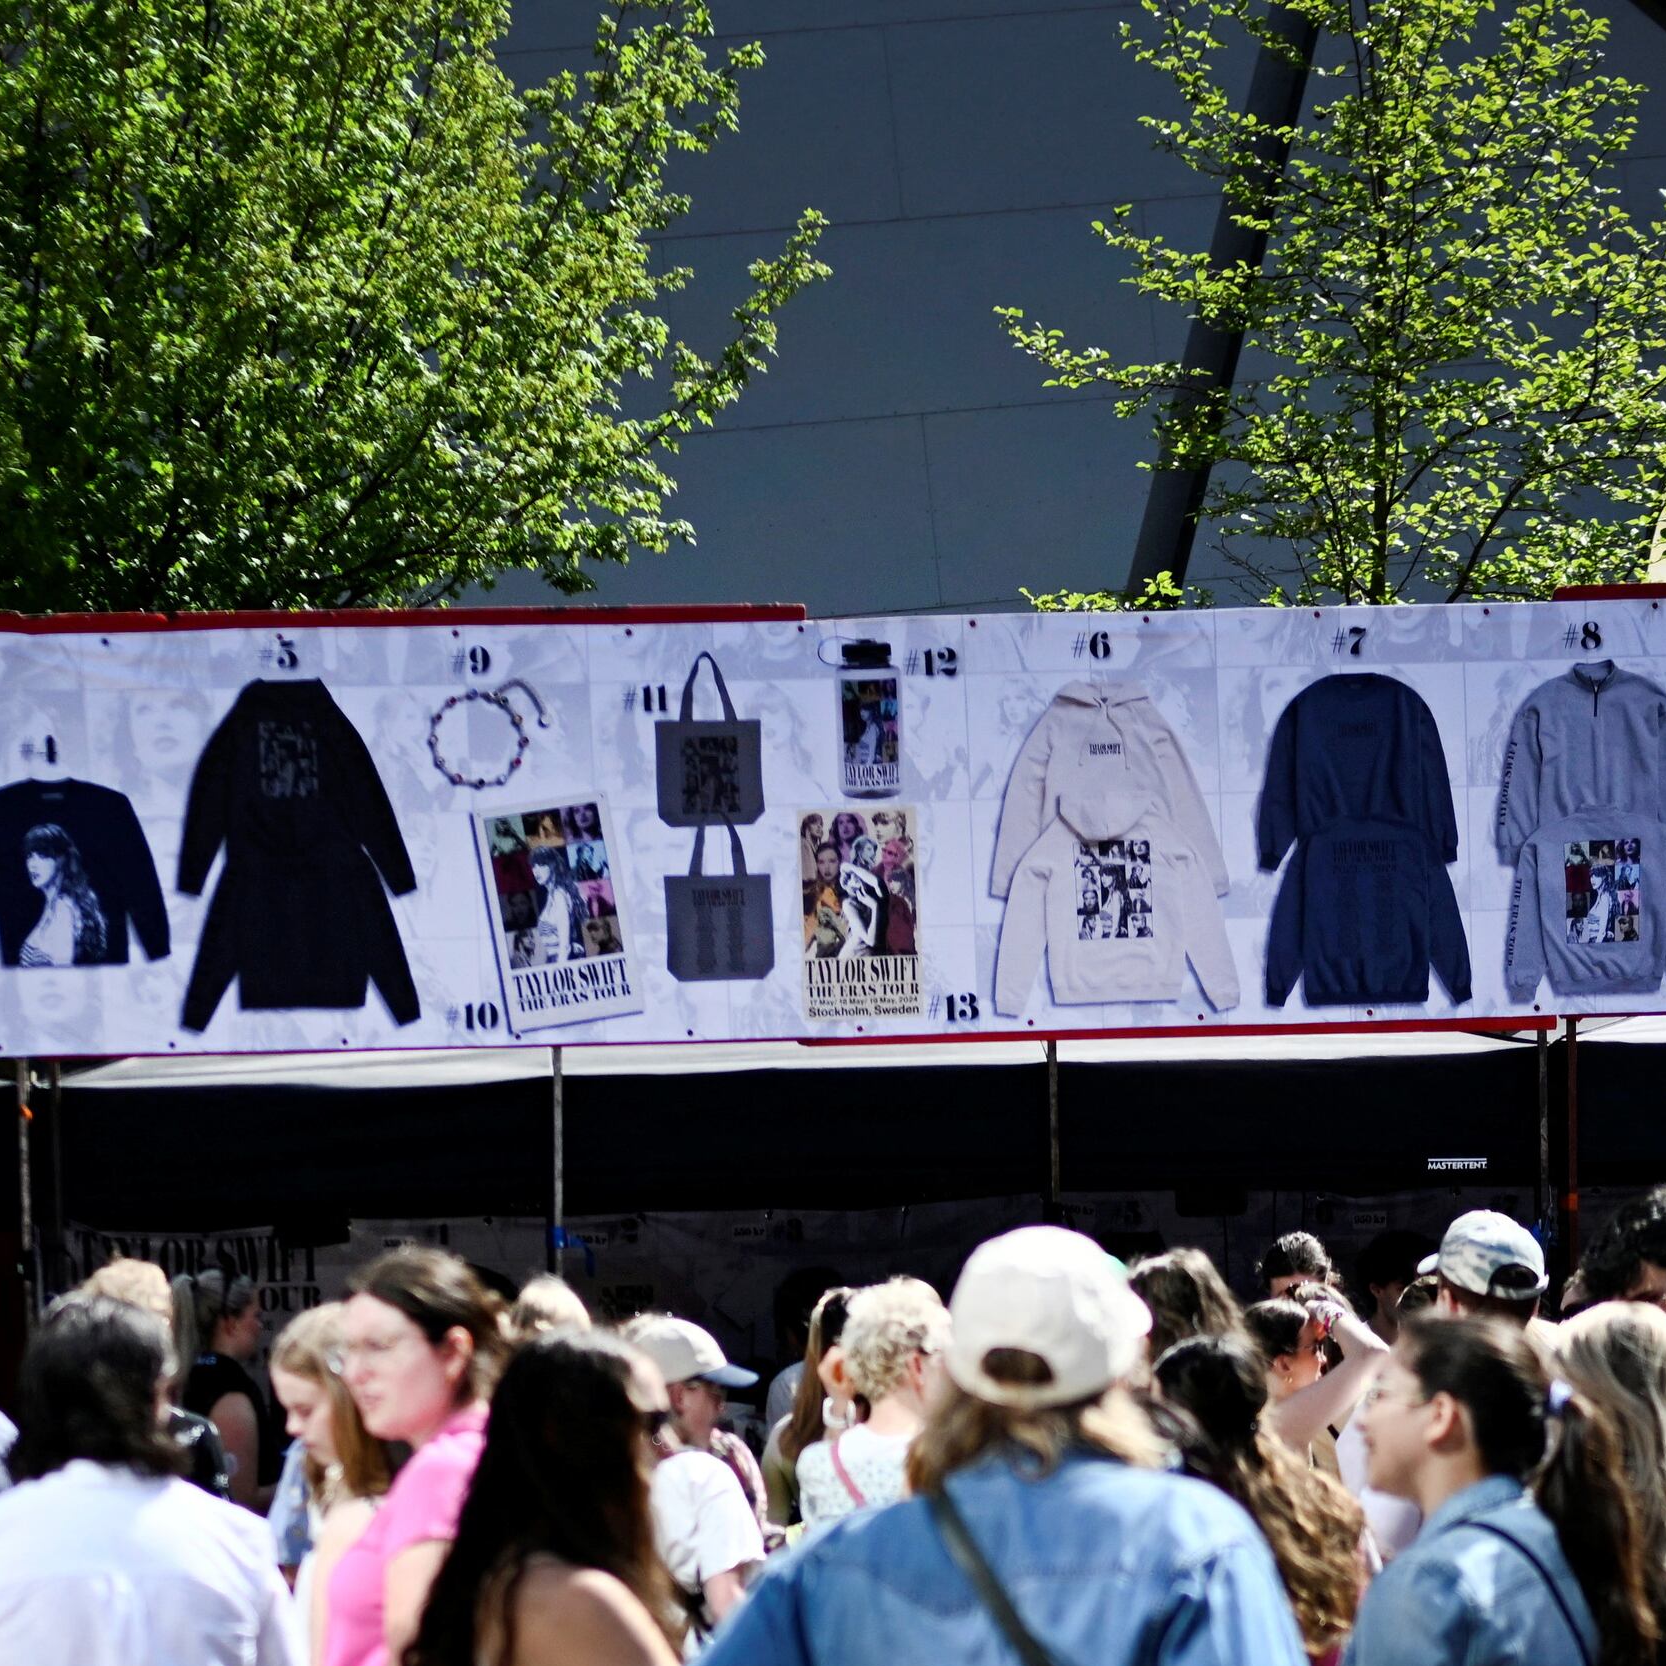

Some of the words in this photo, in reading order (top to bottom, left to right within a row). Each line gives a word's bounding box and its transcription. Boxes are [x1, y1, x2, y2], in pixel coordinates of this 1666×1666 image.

[1071, 630, 1112, 660] #6
[1331, 626, 1367, 656] #7
[1563, 621, 1602, 650] #8
[258, 639, 299, 670] #5
[450, 644, 491, 675] #9
[904, 646, 958, 677] #12
[623, 683, 667, 712] #11
[513, 966, 578, 999] TAYLOR
[580, 958, 627, 989] SWIFT
[805, 958, 866, 985] TAYLOR
[870, 956, 919, 982] SWIFT
[517, 996, 549, 1013] THE
[552, 989, 588, 1008] ERAS
[593, 983, 631, 1003] TOUR
[807, 986, 837, 998] THE
[840, 984, 877, 997] ERAS
[880, 982, 919, 996] TOUR
[445, 1001, 499, 1031] #10
[808, 1004, 871, 1018] Stockholm,
[874, 1003, 919, 1015] Sweden
[927, 991, 980, 1021] #13
[1427, 1162, 1487, 1170] MASTERTENT
[260, 1286, 321, 1312] OUR
